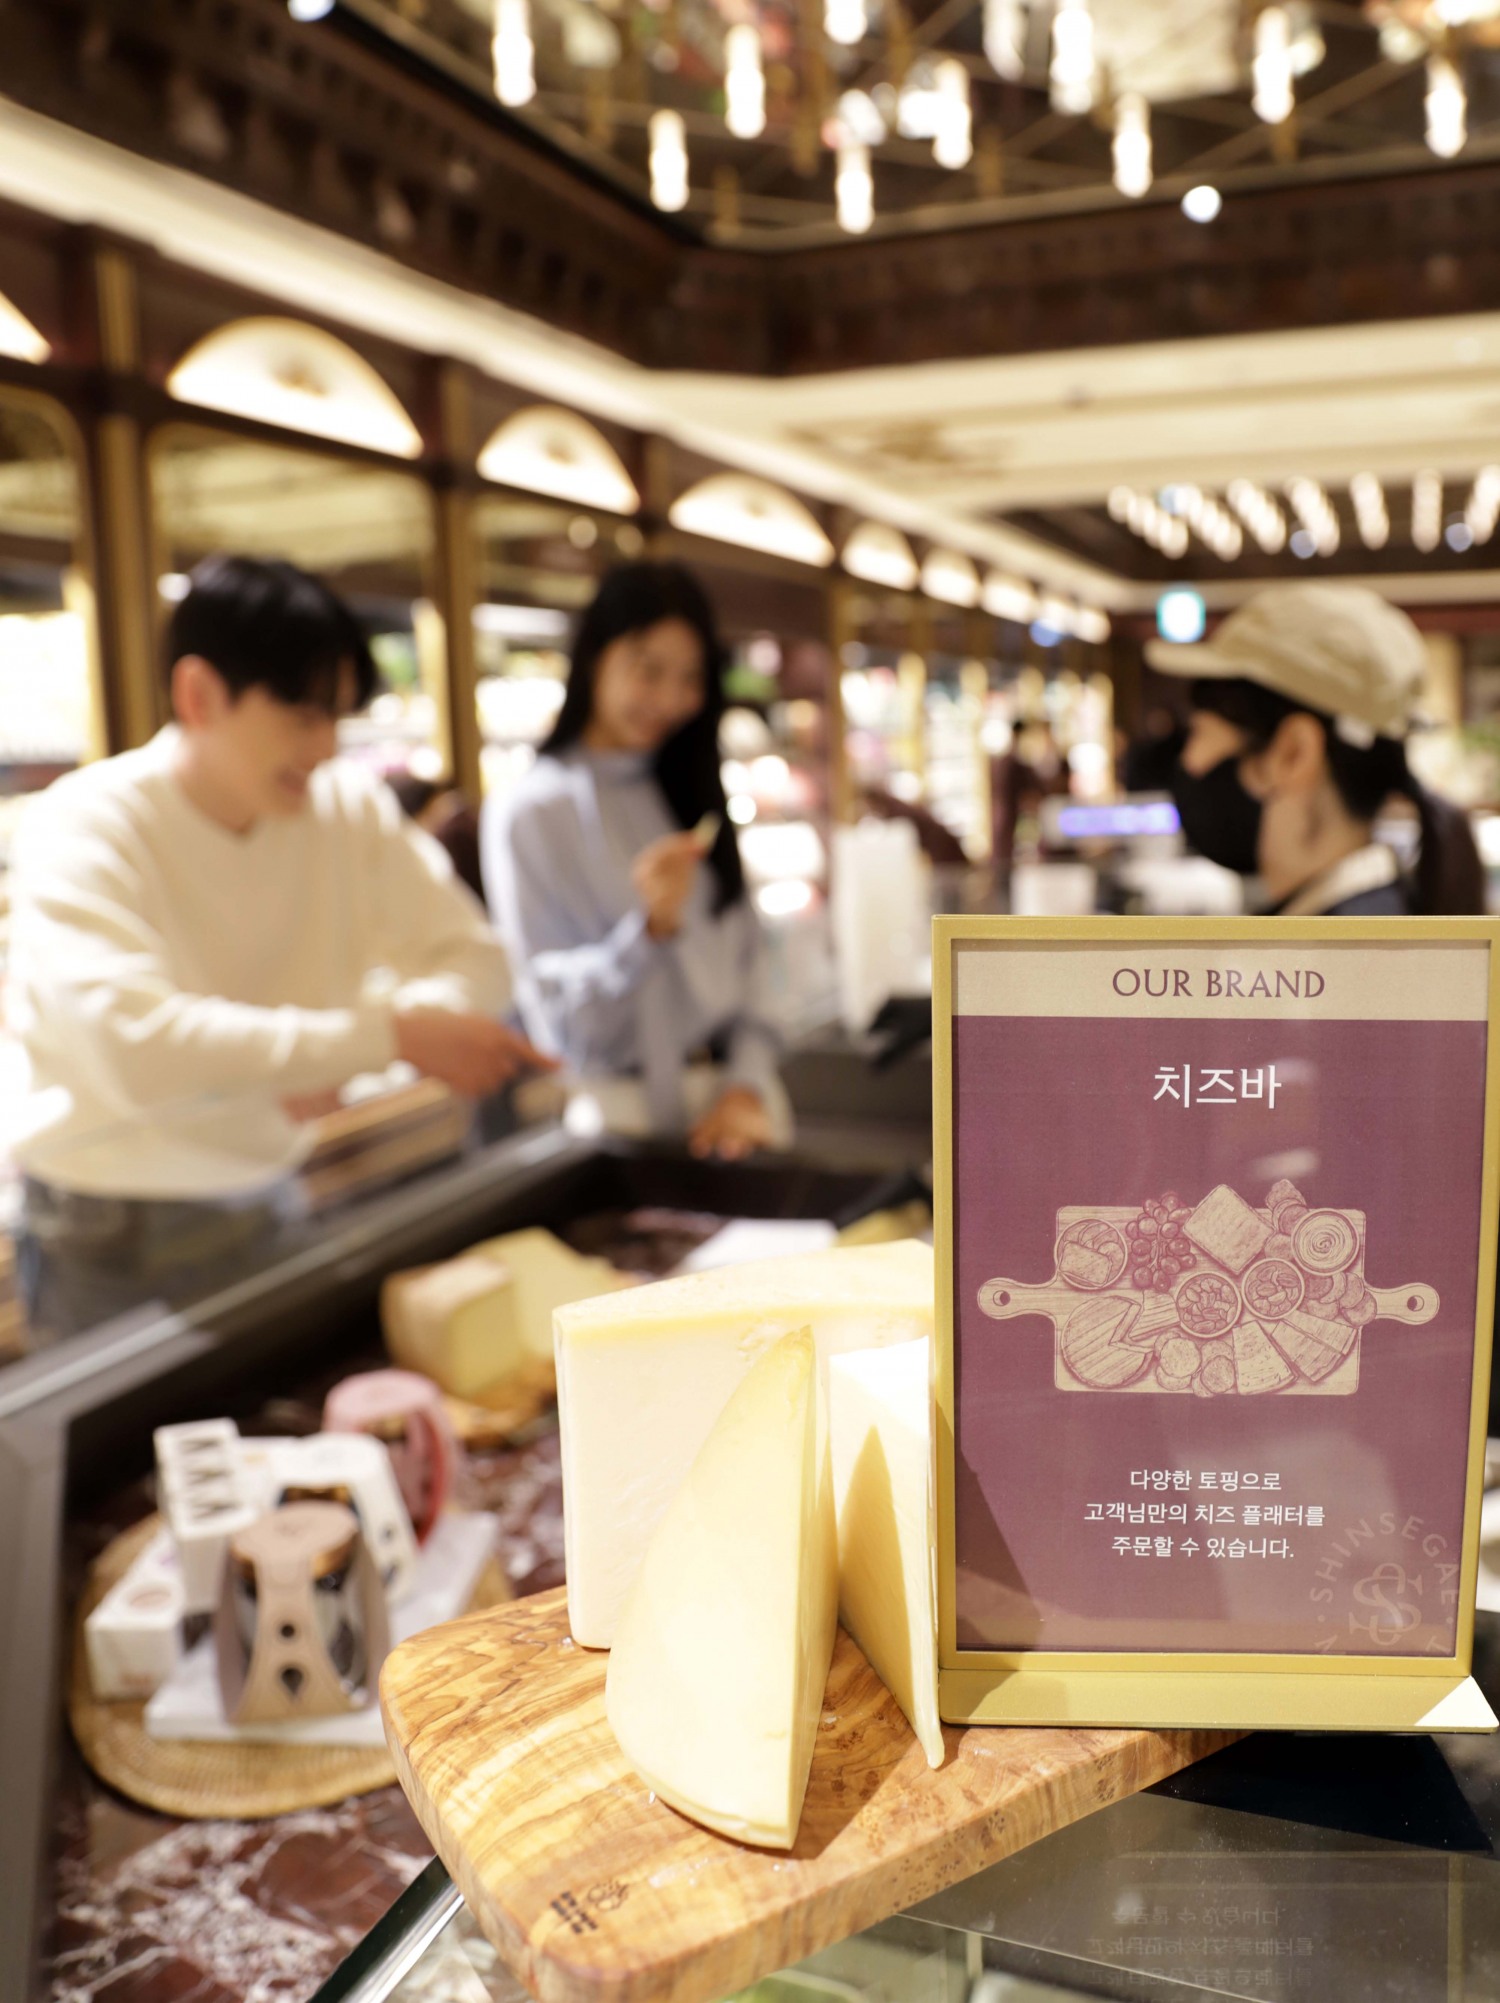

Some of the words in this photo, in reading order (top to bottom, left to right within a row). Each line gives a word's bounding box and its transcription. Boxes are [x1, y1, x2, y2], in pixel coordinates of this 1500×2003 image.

[1112, 968, 1193, 998] OUR
[1205, 969, 1326, 999] BRAND
[1152, 1063, 1282, 1110] 치즈바
[1130, 1468, 1193, 1491] 다양한
[1197, 1470, 1282, 1493] 토핑으로
[1083, 1501, 1187, 1525] 고객님만의
[1194, 1503, 1236, 1525] 치즈
[1241, 1504, 1326, 1527] 플래터를
[1111, 1535, 1175, 1558] 주문할
[1179, 1537, 1201, 1558] 수
[1206, 1536, 1294, 1560] 있습니다.
[1309, 1511, 1460, 1606] SHINSEGAE
